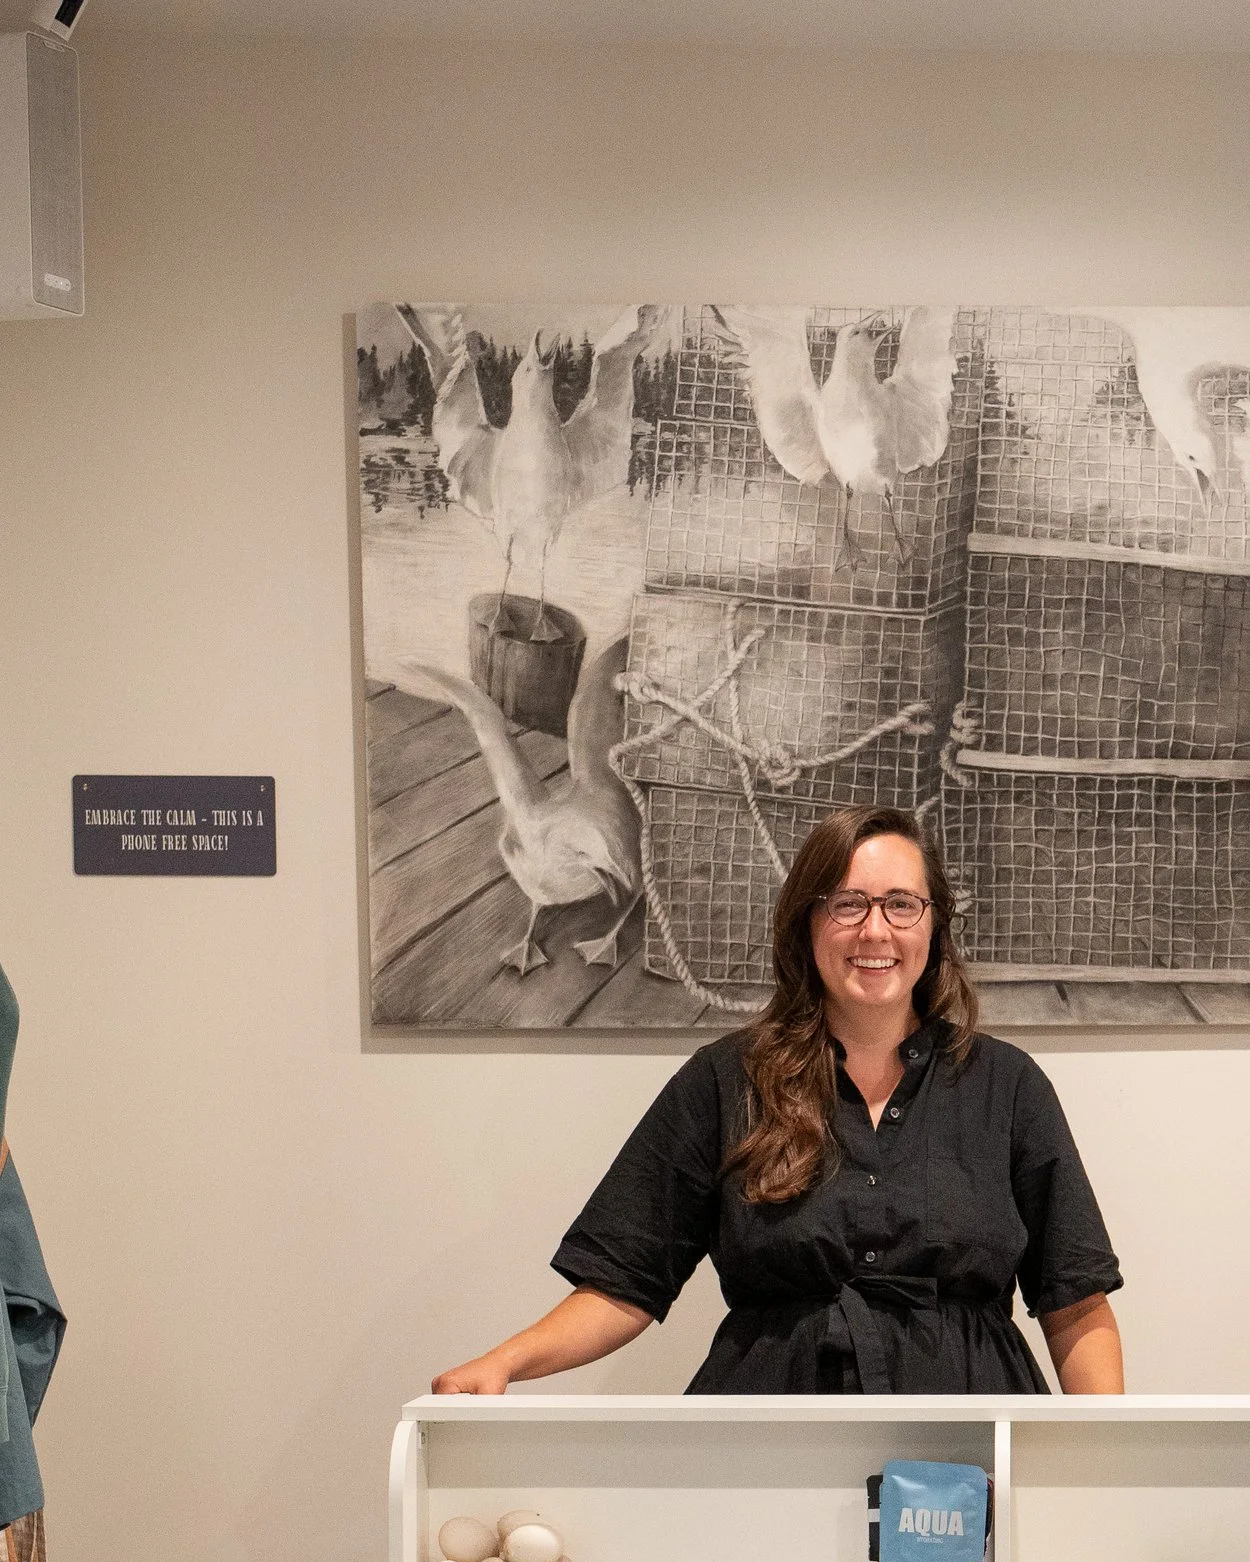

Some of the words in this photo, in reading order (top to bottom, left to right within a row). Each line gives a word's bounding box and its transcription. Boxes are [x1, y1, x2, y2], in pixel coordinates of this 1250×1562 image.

[85, 809, 136, 826] EMBRACE
[141, 810, 162, 825] THE
[166, 810, 196, 826] CALM
[212, 810, 237, 826] THIS
[242, 810, 253, 826] IS
[256, 810, 263, 826] A
[121, 834, 157, 850] PHONE
[162, 835, 187, 850] FREE
[192, 835, 229, 850] SPACE!
[898, 1507, 964, 1536] AQUA
